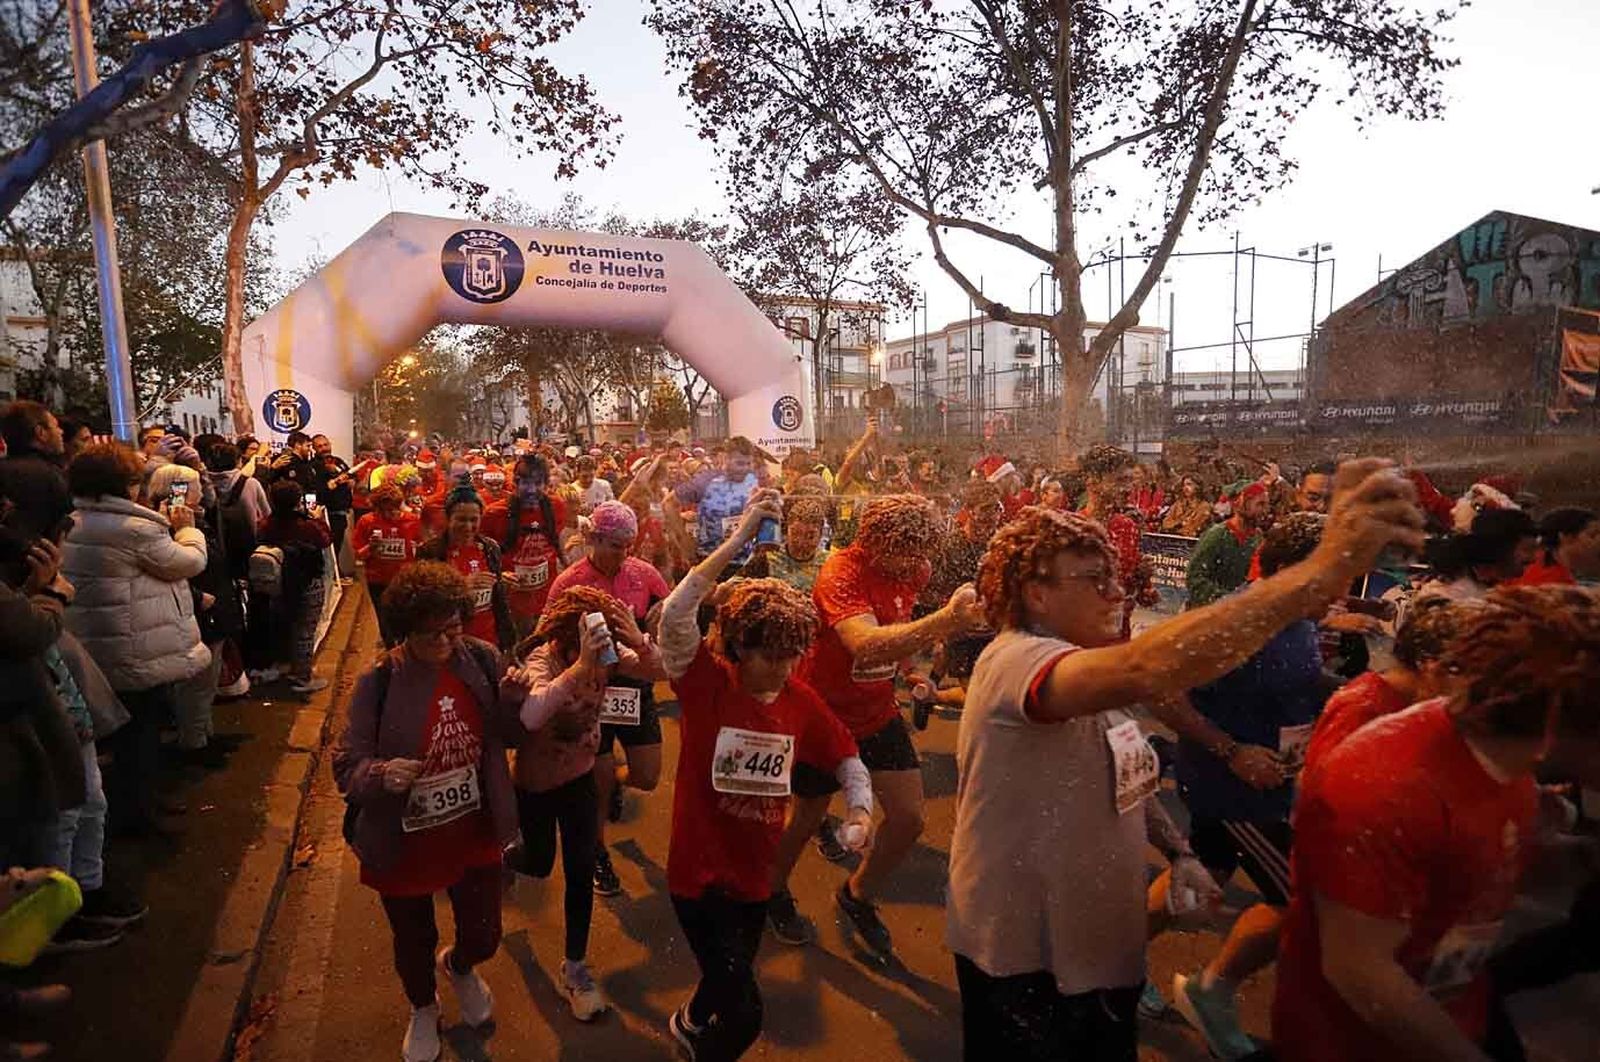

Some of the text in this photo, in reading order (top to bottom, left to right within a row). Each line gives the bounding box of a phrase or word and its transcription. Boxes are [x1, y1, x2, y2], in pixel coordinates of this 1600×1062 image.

[527, 240, 664, 263] Ayuntamiento
[568, 259, 665, 279] de Huelva
[600, 280, 614, 290] de
[617, 281, 667, 293] Deportes
[1254, 409, 1298, 420] HYUNDAI
[1342, 405, 1396, 418] HYUNDAI
[1434, 400, 1500, 416] HYUNDAI
[611, 697, 636, 714] 353
[744, 751, 785, 777] 448
[432, 783, 471, 810] 398
